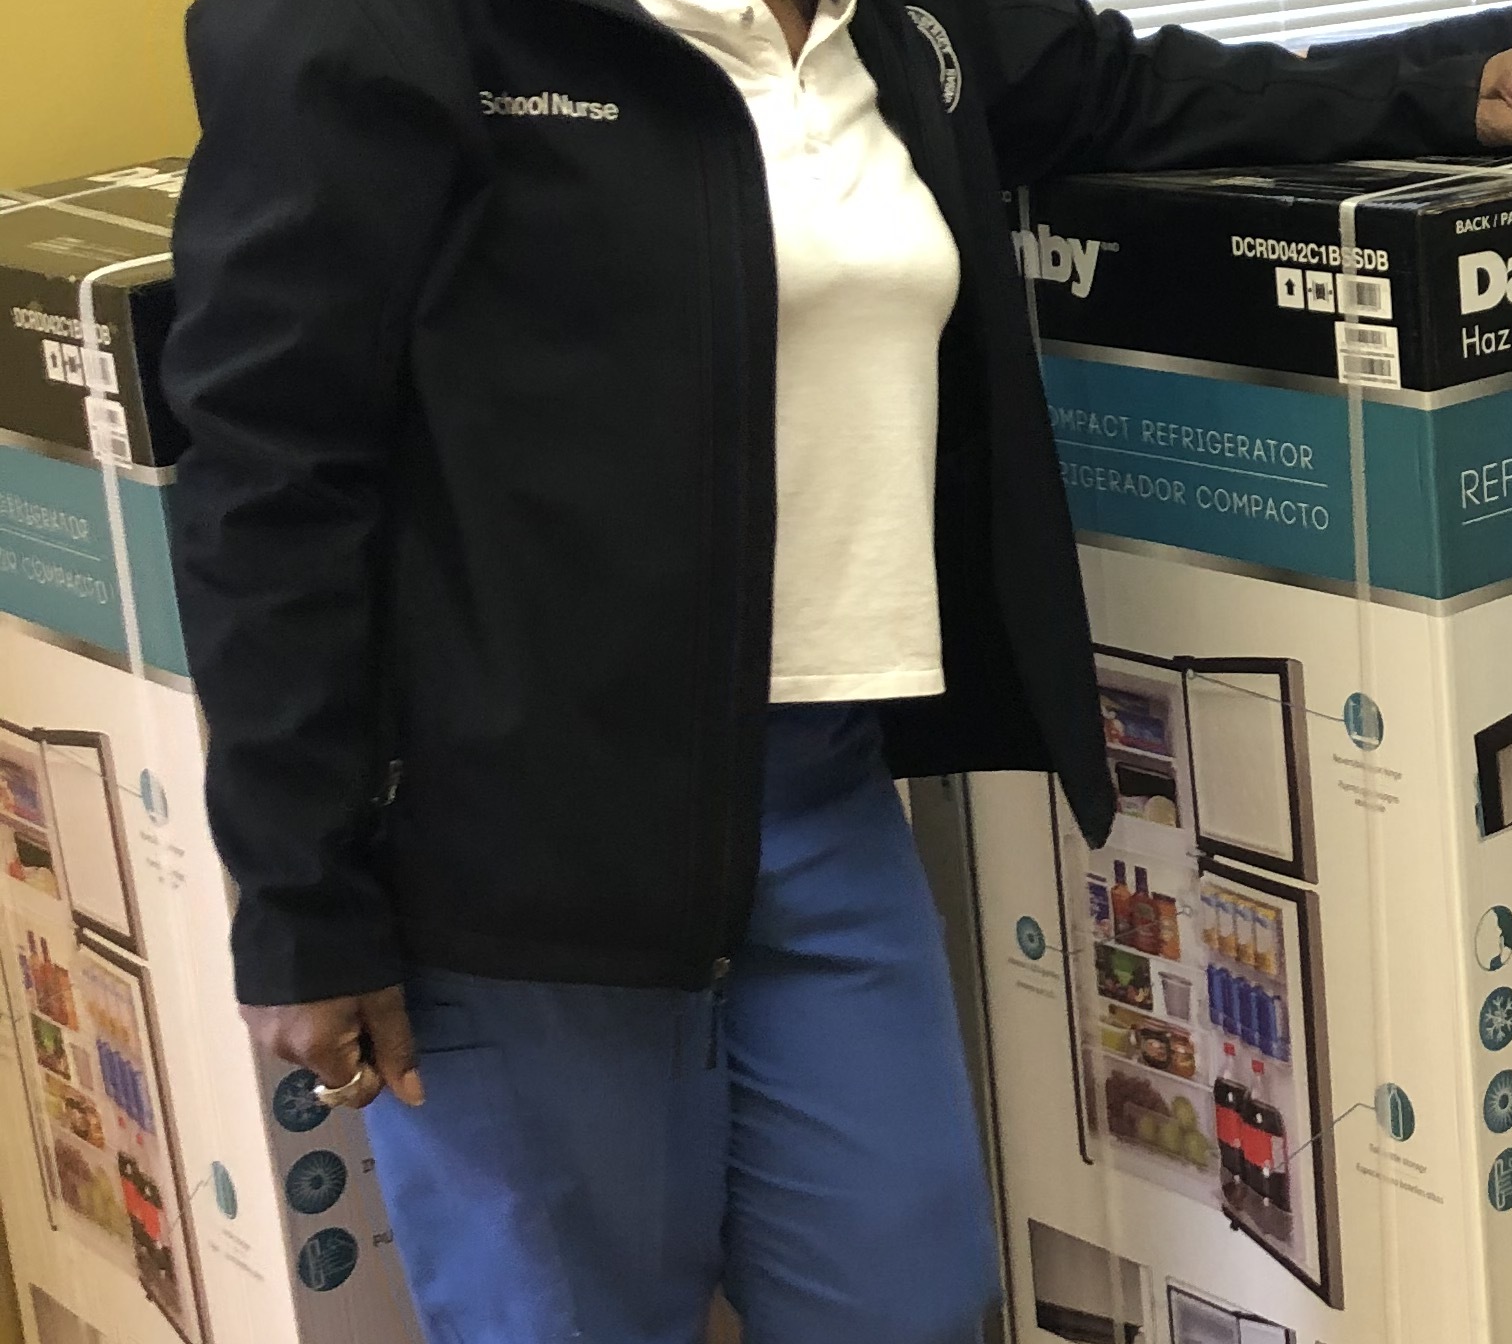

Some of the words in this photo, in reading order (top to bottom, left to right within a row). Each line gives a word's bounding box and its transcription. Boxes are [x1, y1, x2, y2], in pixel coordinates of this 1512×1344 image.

[552, 92, 620, 121] Nurse
[1455, 215, 1491, 235] BACK
[1010, 224, 1101, 298] nby
[1462, 324, 1511, 358] Haz
[1141, 419, 1314, 470] REFRIGERATOR
[1195, 485, 1330, 531] COMPACTO
